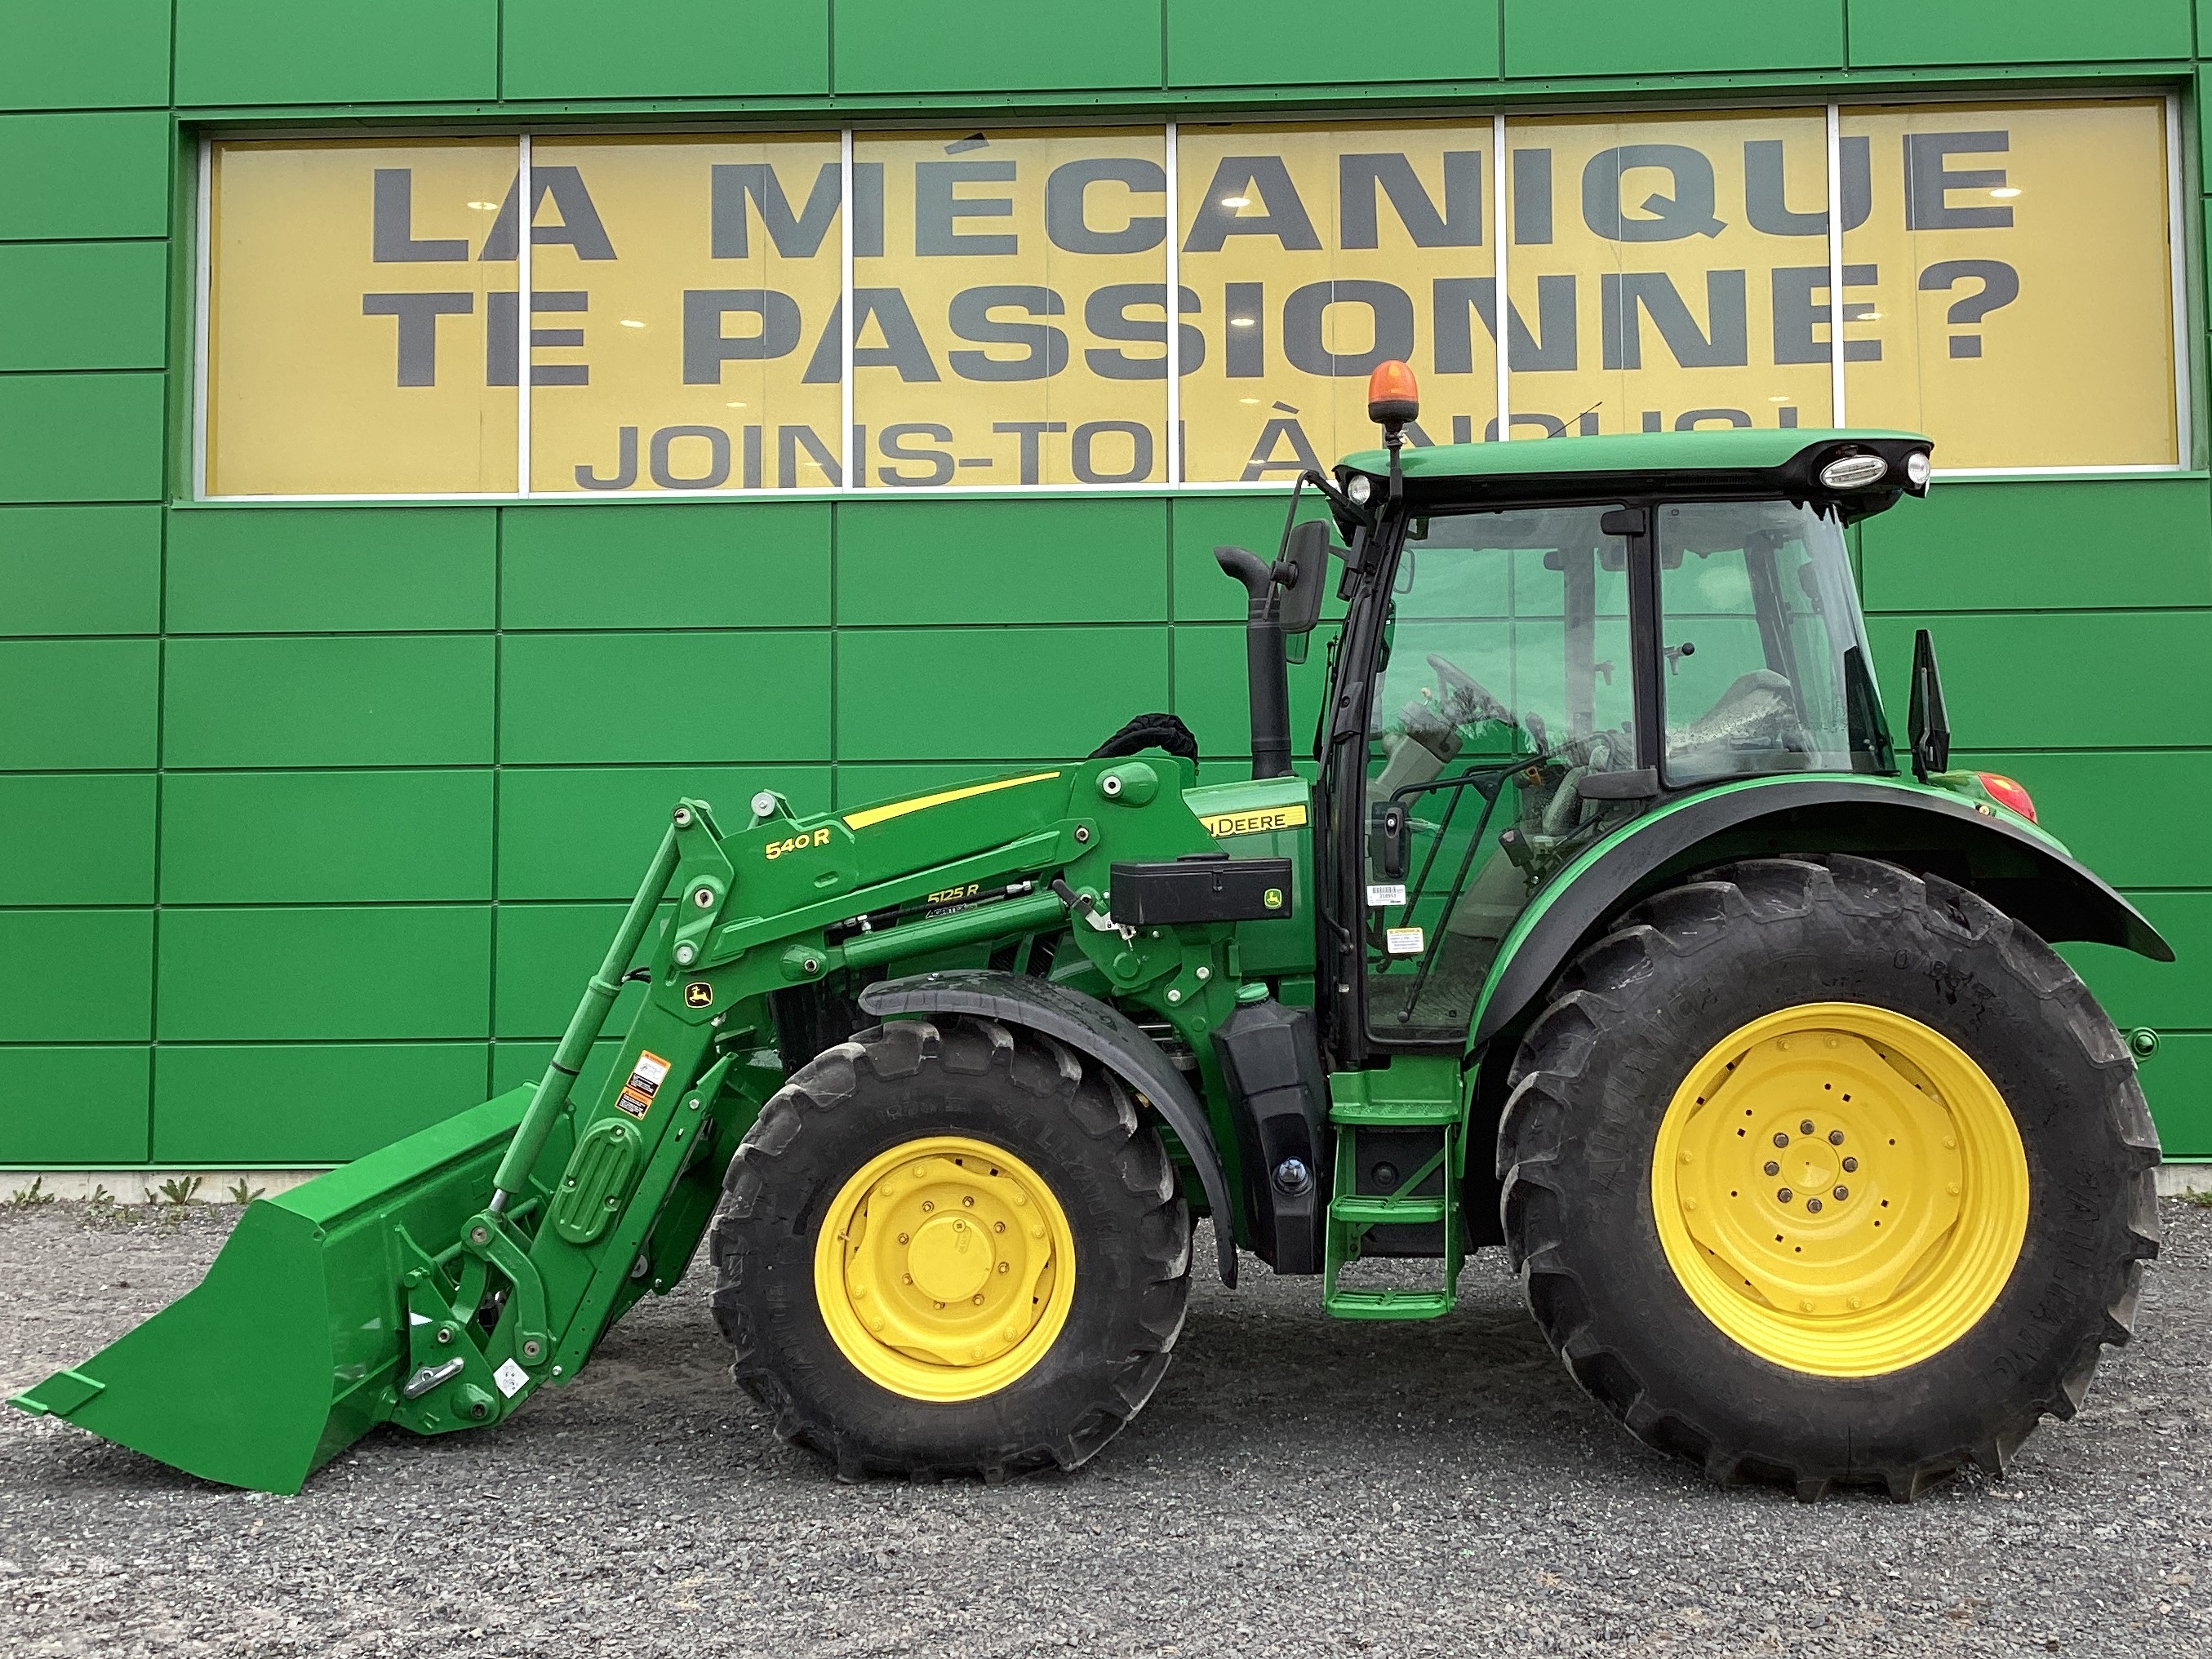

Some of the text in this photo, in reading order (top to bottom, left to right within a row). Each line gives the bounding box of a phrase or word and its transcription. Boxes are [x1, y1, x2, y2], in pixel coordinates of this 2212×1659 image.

[373, 130, 2014, 262] LA MÉCANIQUE
[362, 291, 589, 387] TE
[1239, 401, 1328, 481] À
[765, 827, 831, 861] 540 R
[1219, 814, 1286, 834] DEERE
[927, 884, 979, 903] 5125 R
